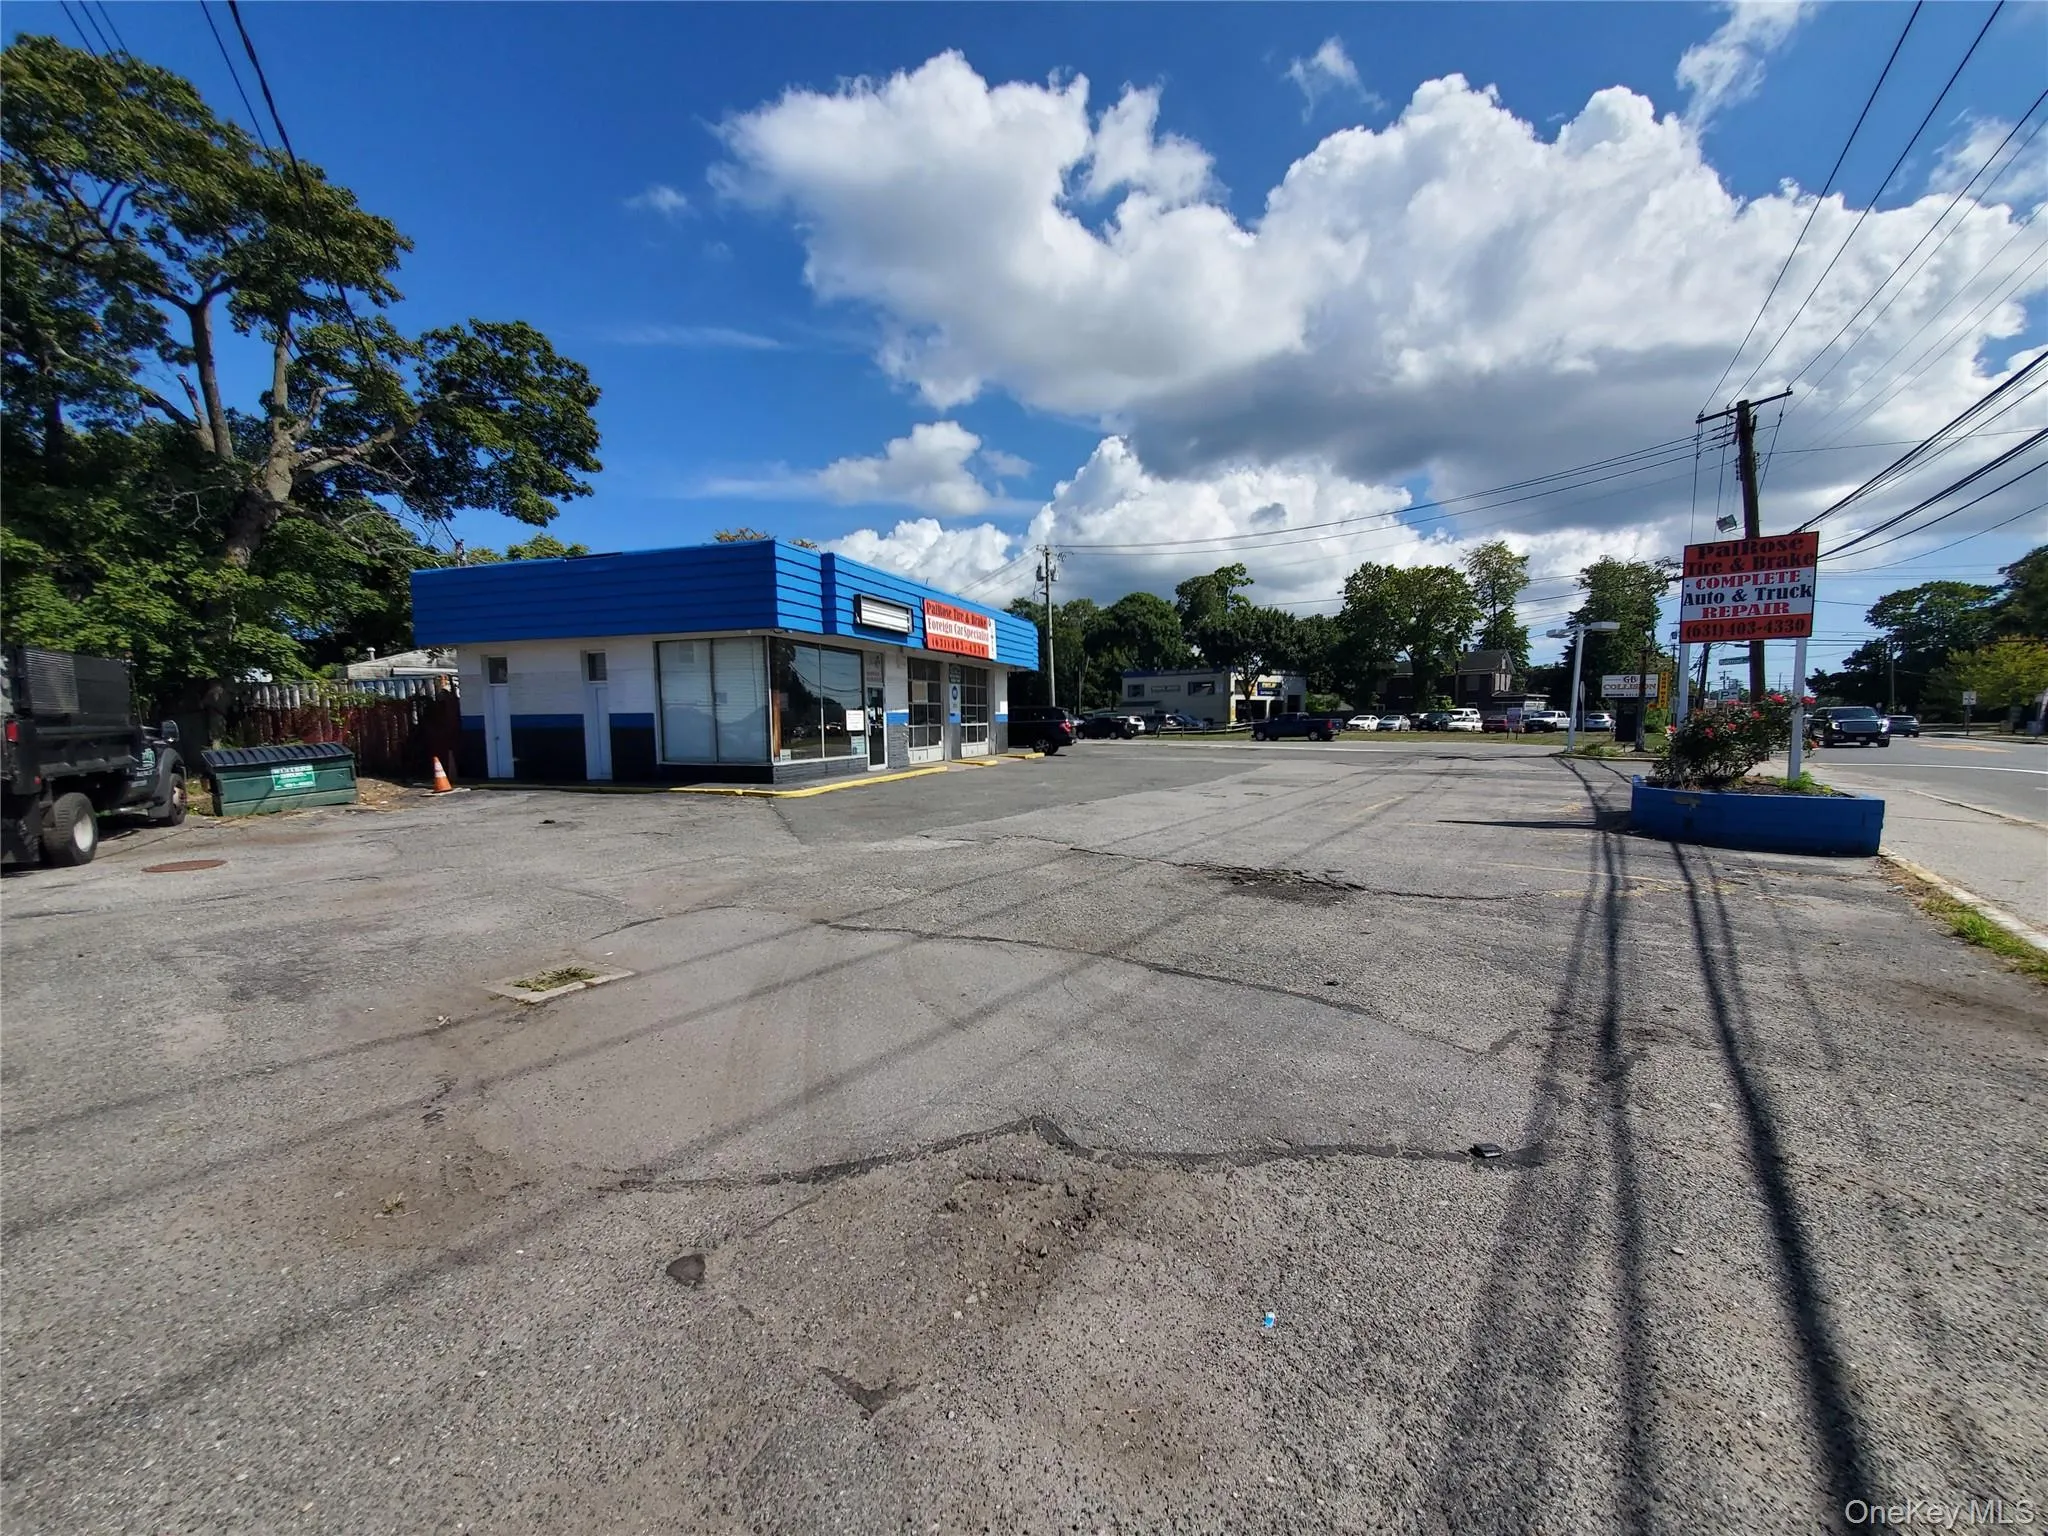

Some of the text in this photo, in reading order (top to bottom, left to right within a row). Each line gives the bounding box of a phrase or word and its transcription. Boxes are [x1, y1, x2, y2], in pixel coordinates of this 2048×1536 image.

[1698, 537, 1804, 559] PalRose
[1687, 552, 1814, 576] Tire & Brake
[1695, 570, 1801, 590] COMPLETE
[1683, 583, 1812, 606] Auto & Truck
[1702, 602, 1790, 619] REPAIR
[927, 617, 953, 634] Foreign
[954, 623, 963, 636] Car
[1686, 623, 1724, 638] (631)
